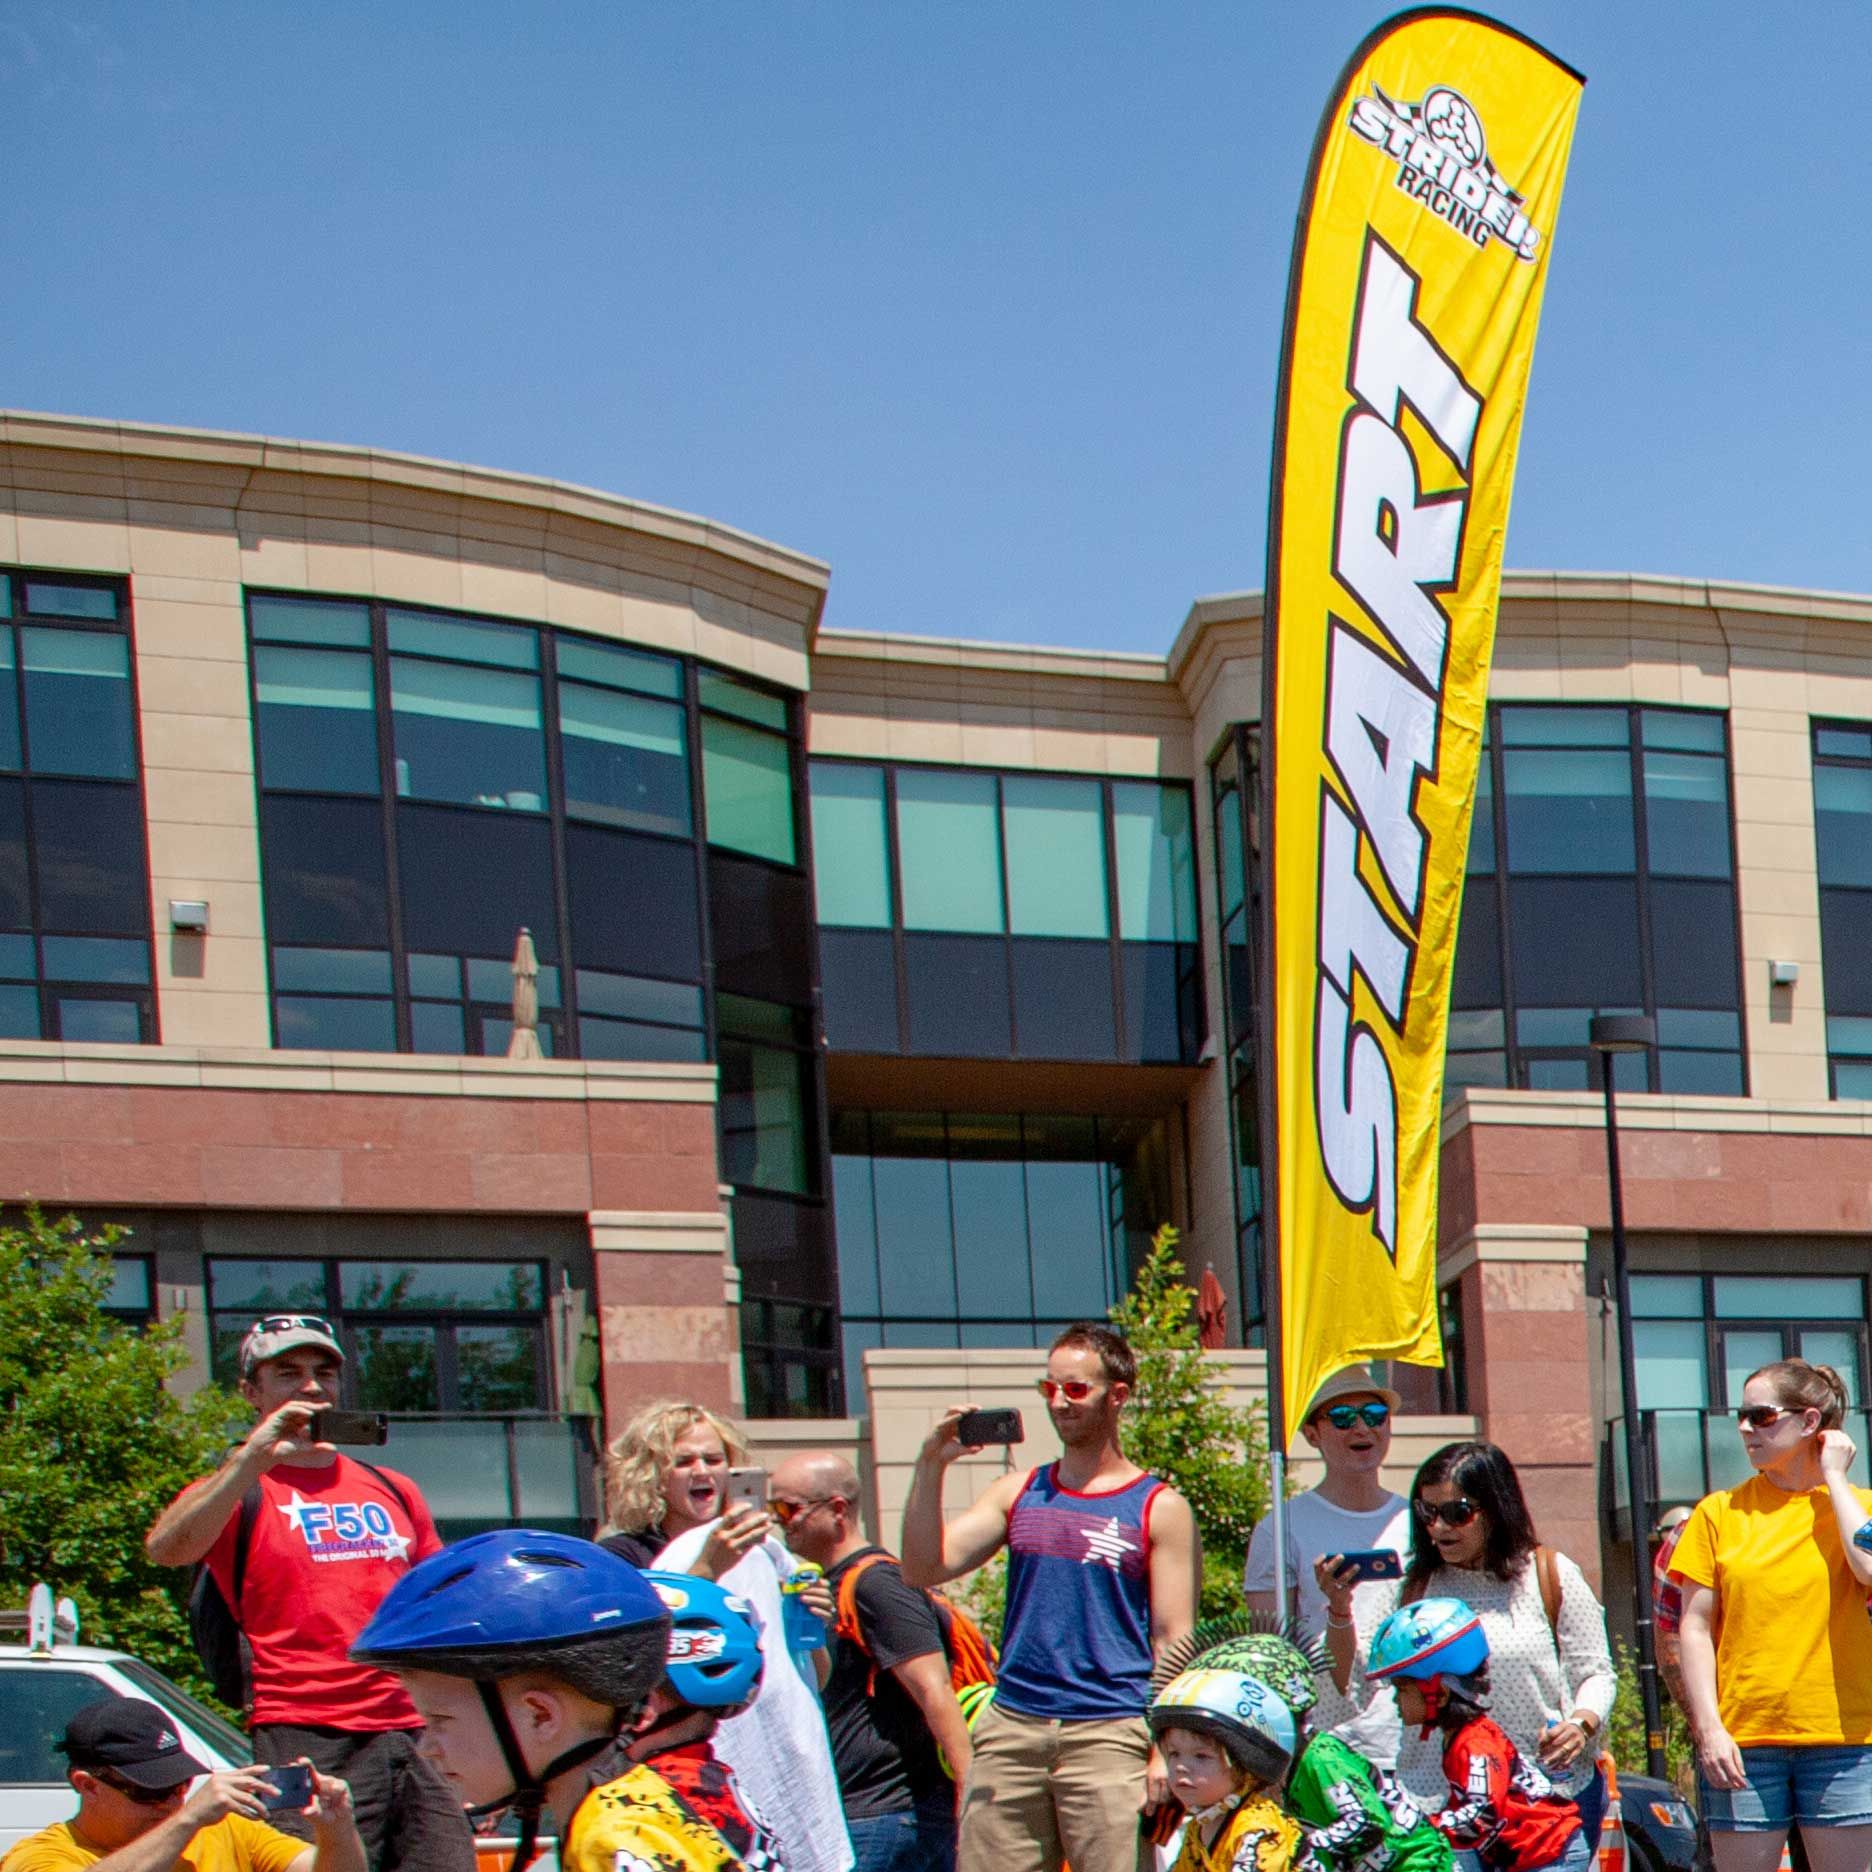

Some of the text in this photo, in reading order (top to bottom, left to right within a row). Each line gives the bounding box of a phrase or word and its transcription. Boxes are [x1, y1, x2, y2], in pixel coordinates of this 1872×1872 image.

[1397, 164, 1490, 249] RACING
[1314, 222, 1485, 1263] START
[297, 1501, 396, 1545] F50
